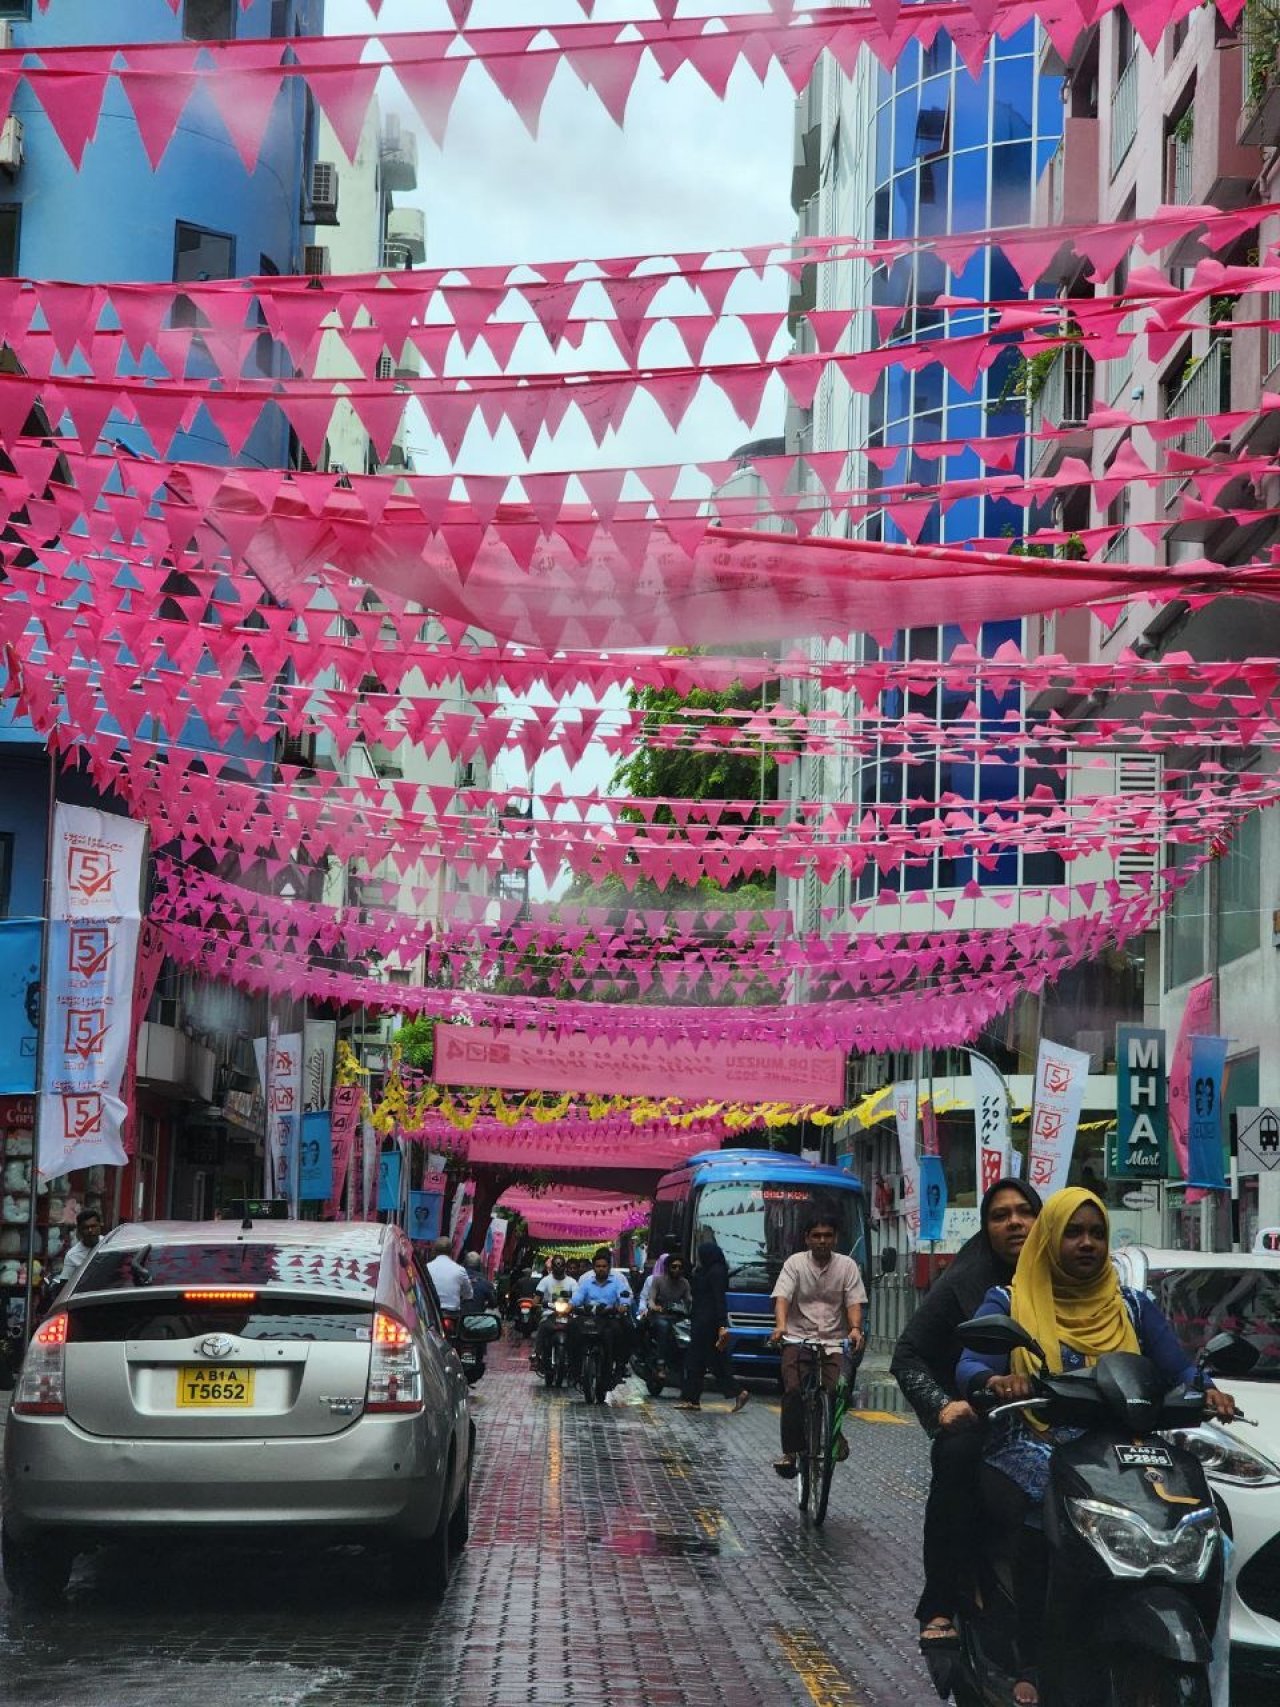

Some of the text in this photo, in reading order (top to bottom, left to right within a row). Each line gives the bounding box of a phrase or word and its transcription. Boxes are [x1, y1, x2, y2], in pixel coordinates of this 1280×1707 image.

[79, 855, 100, 881] 5
[77, 935, 97, 962] 5
[76, 1017, 92, 1044] 5
[1050, 1069, 1061, 1085] 5
[339, 1090, 351, 1102] 4
[1127, 1038, 1159, 1144] MHA
[75, 1099, 90, 1127] 5
[1043, 1116, 1053, 1131] 5
[1125, 1150, 1160, 1166] Mart
[1034, 1161, 1045, 1175] 5
[187, 1384, 245, 1400] T5652
